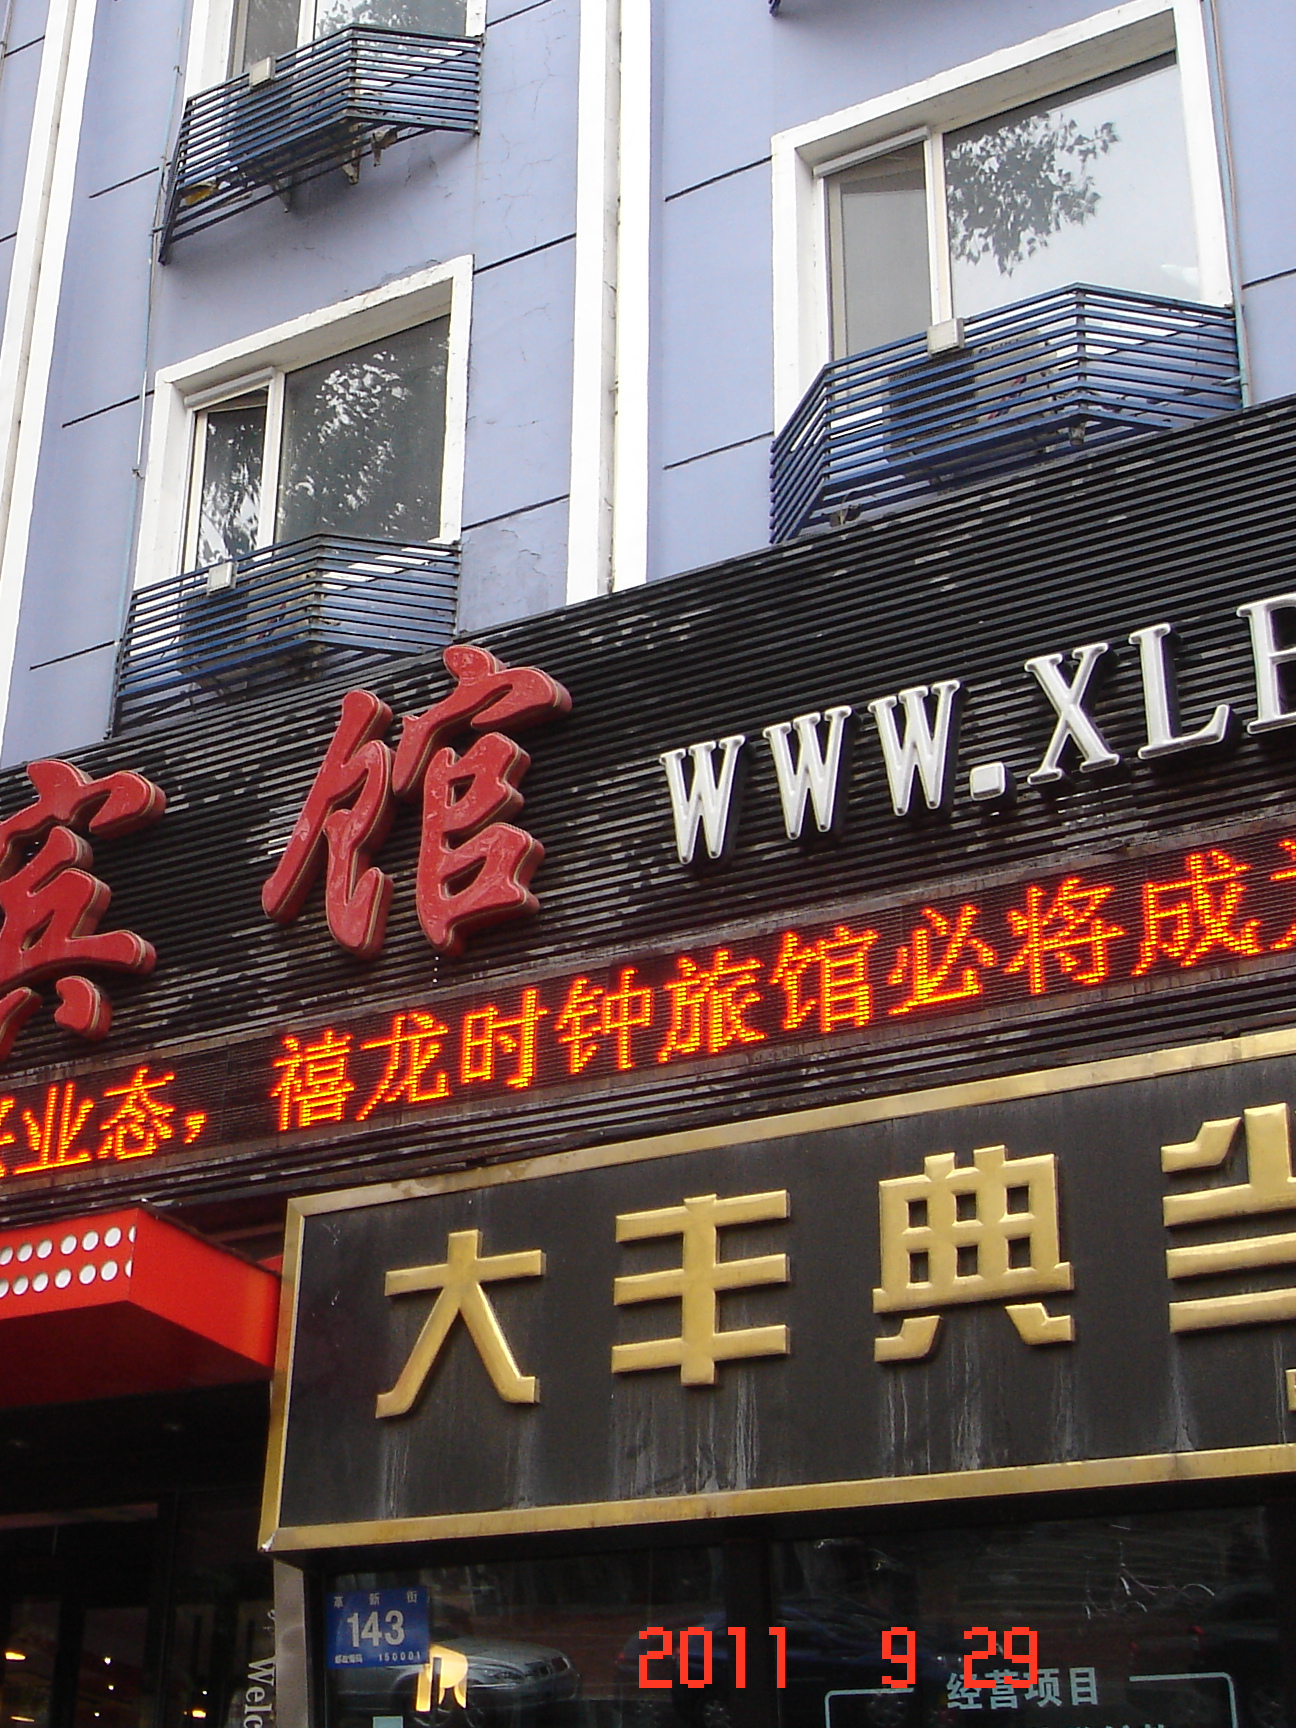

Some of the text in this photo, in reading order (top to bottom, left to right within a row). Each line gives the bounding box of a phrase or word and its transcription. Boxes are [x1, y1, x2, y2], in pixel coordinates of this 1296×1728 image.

[347, 1610, 406, 1648] 143
[378, 1651, 422, 1662] 150001
[946, 1666, 1099, 1710] 经营项目
